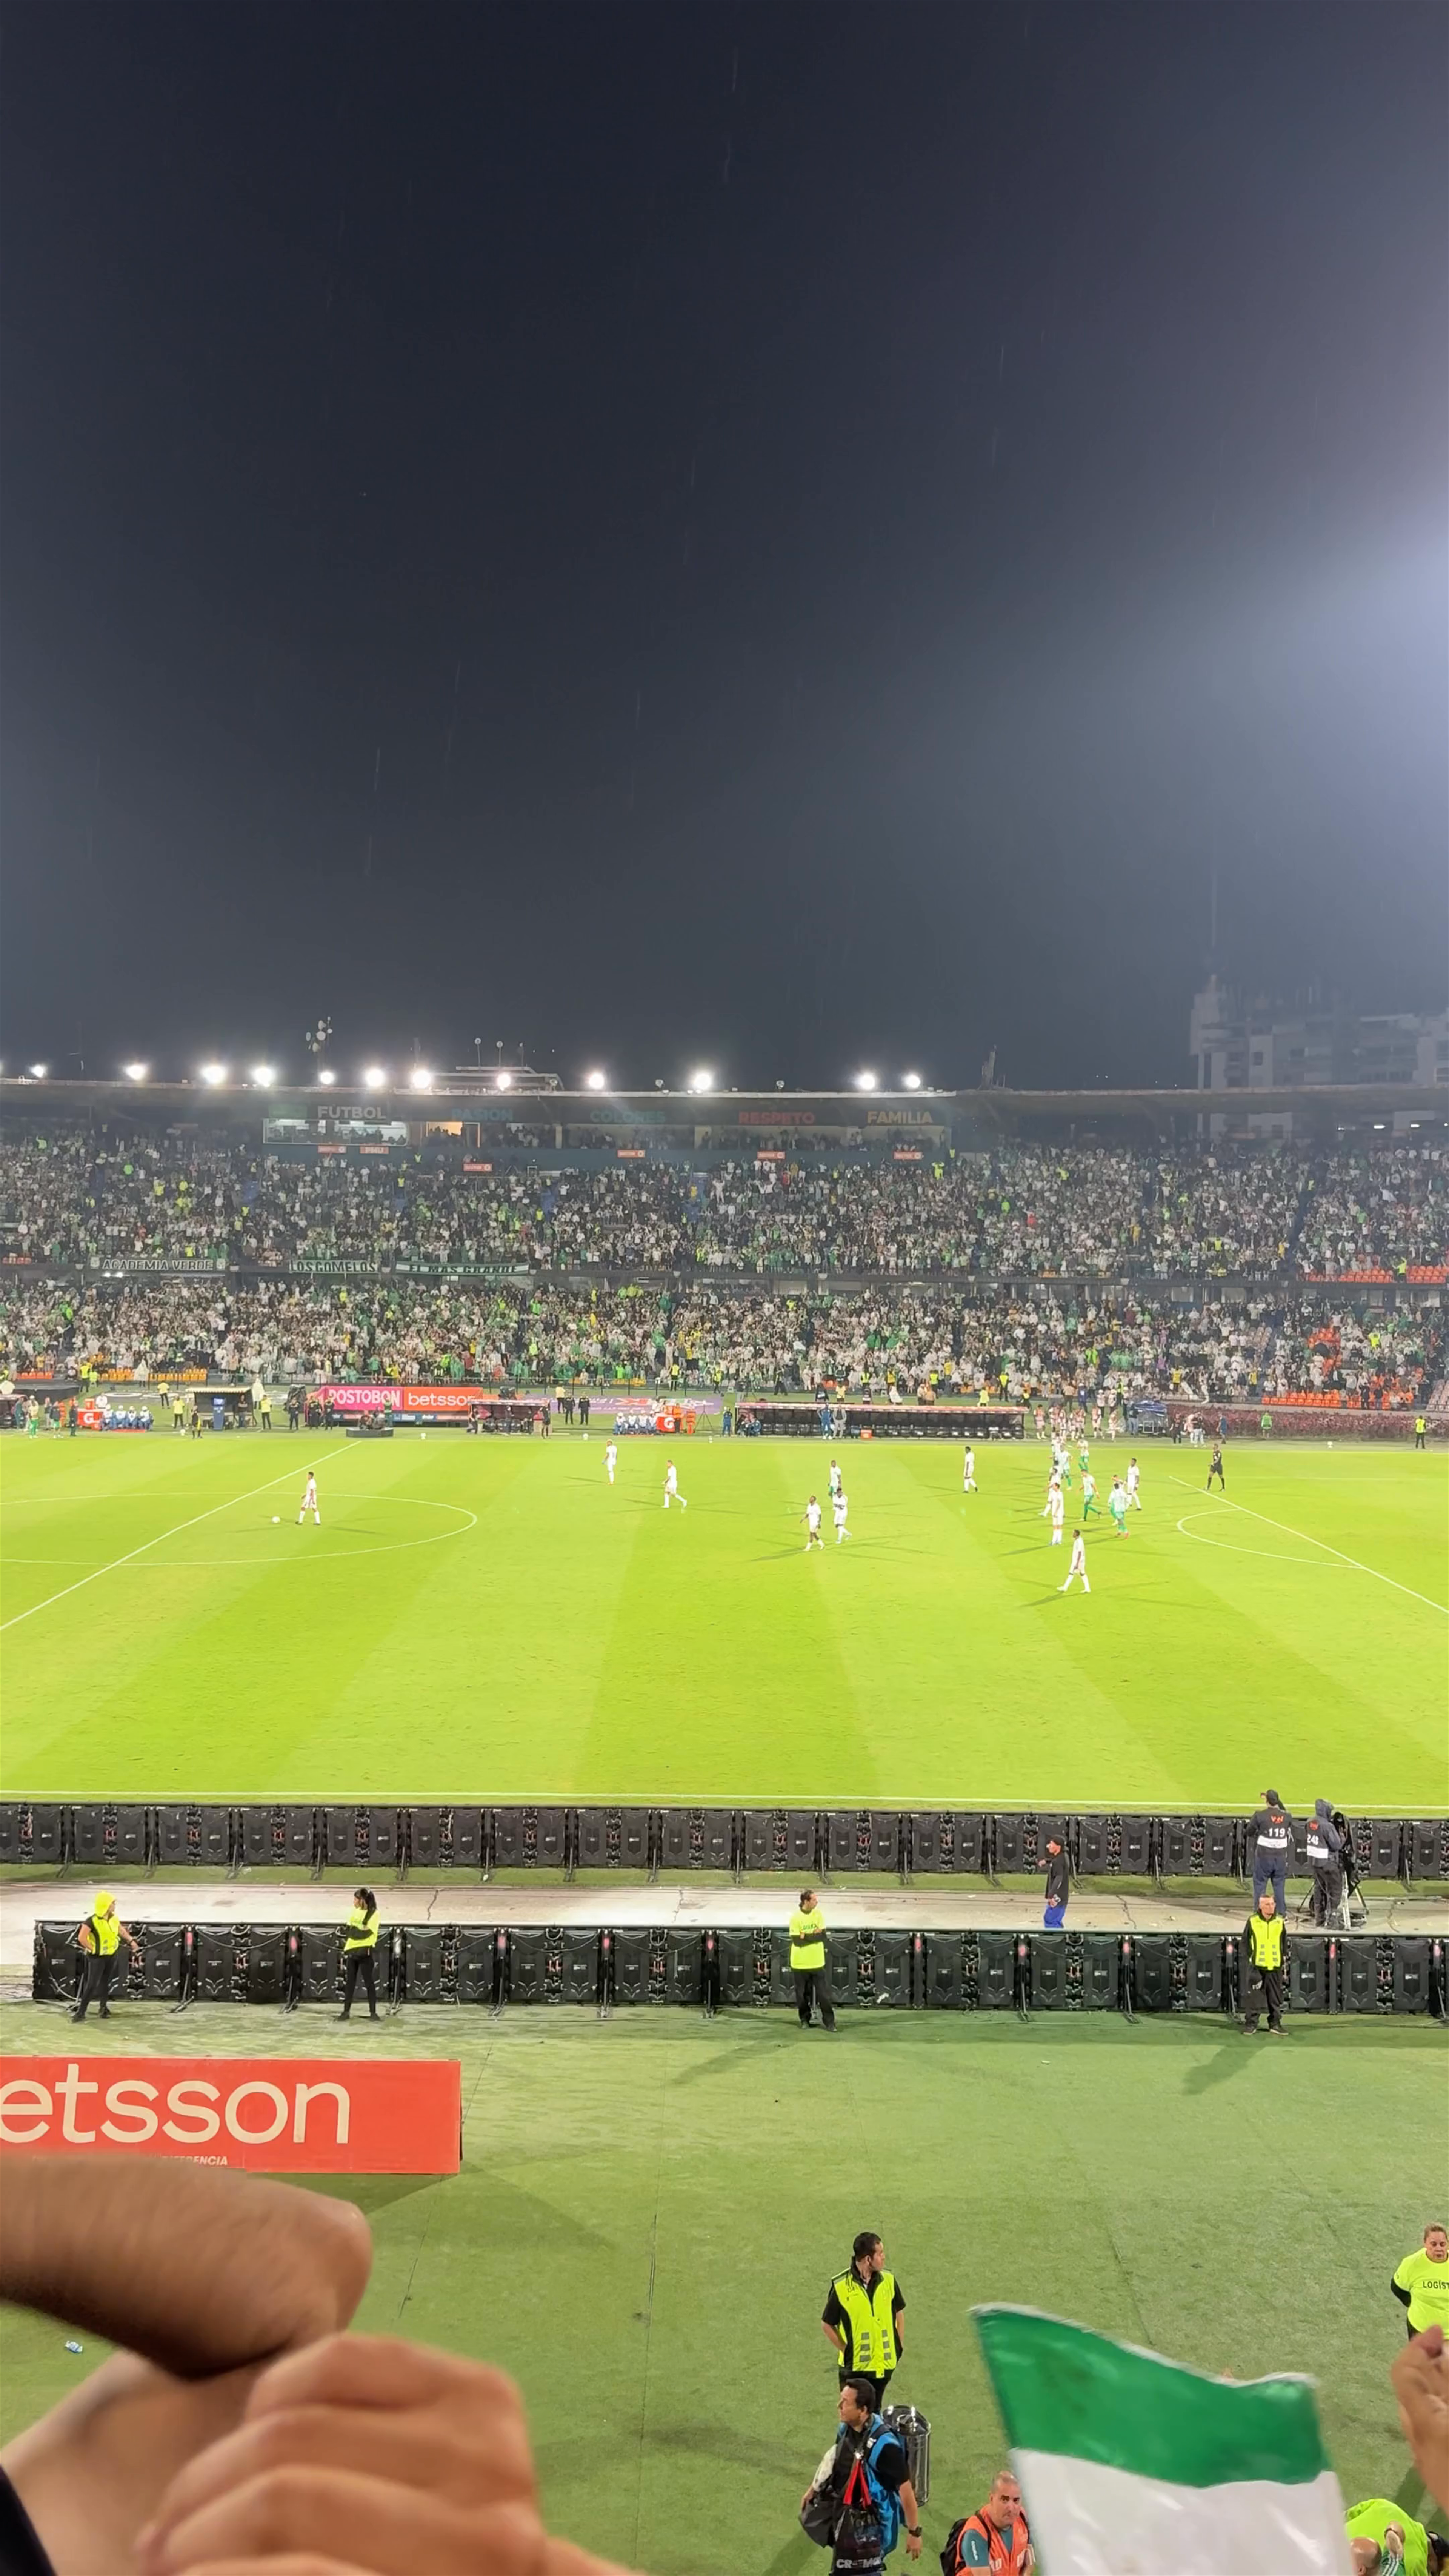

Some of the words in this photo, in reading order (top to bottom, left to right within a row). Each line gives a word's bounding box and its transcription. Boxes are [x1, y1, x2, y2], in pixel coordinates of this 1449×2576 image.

[738, 1111, 815, 1124] RESPETO
[868, 1111, 934, 1124] FAMILIA
[102, 1259, 169, 1270] ACADEMIA
[172, 1259, 214, 1271] VERDE
[291, 1260, 313, 1272] LOS
[315, 1261, 376, 1272] GOMELOS
[1269, 1827, 1286, 1837] 119
